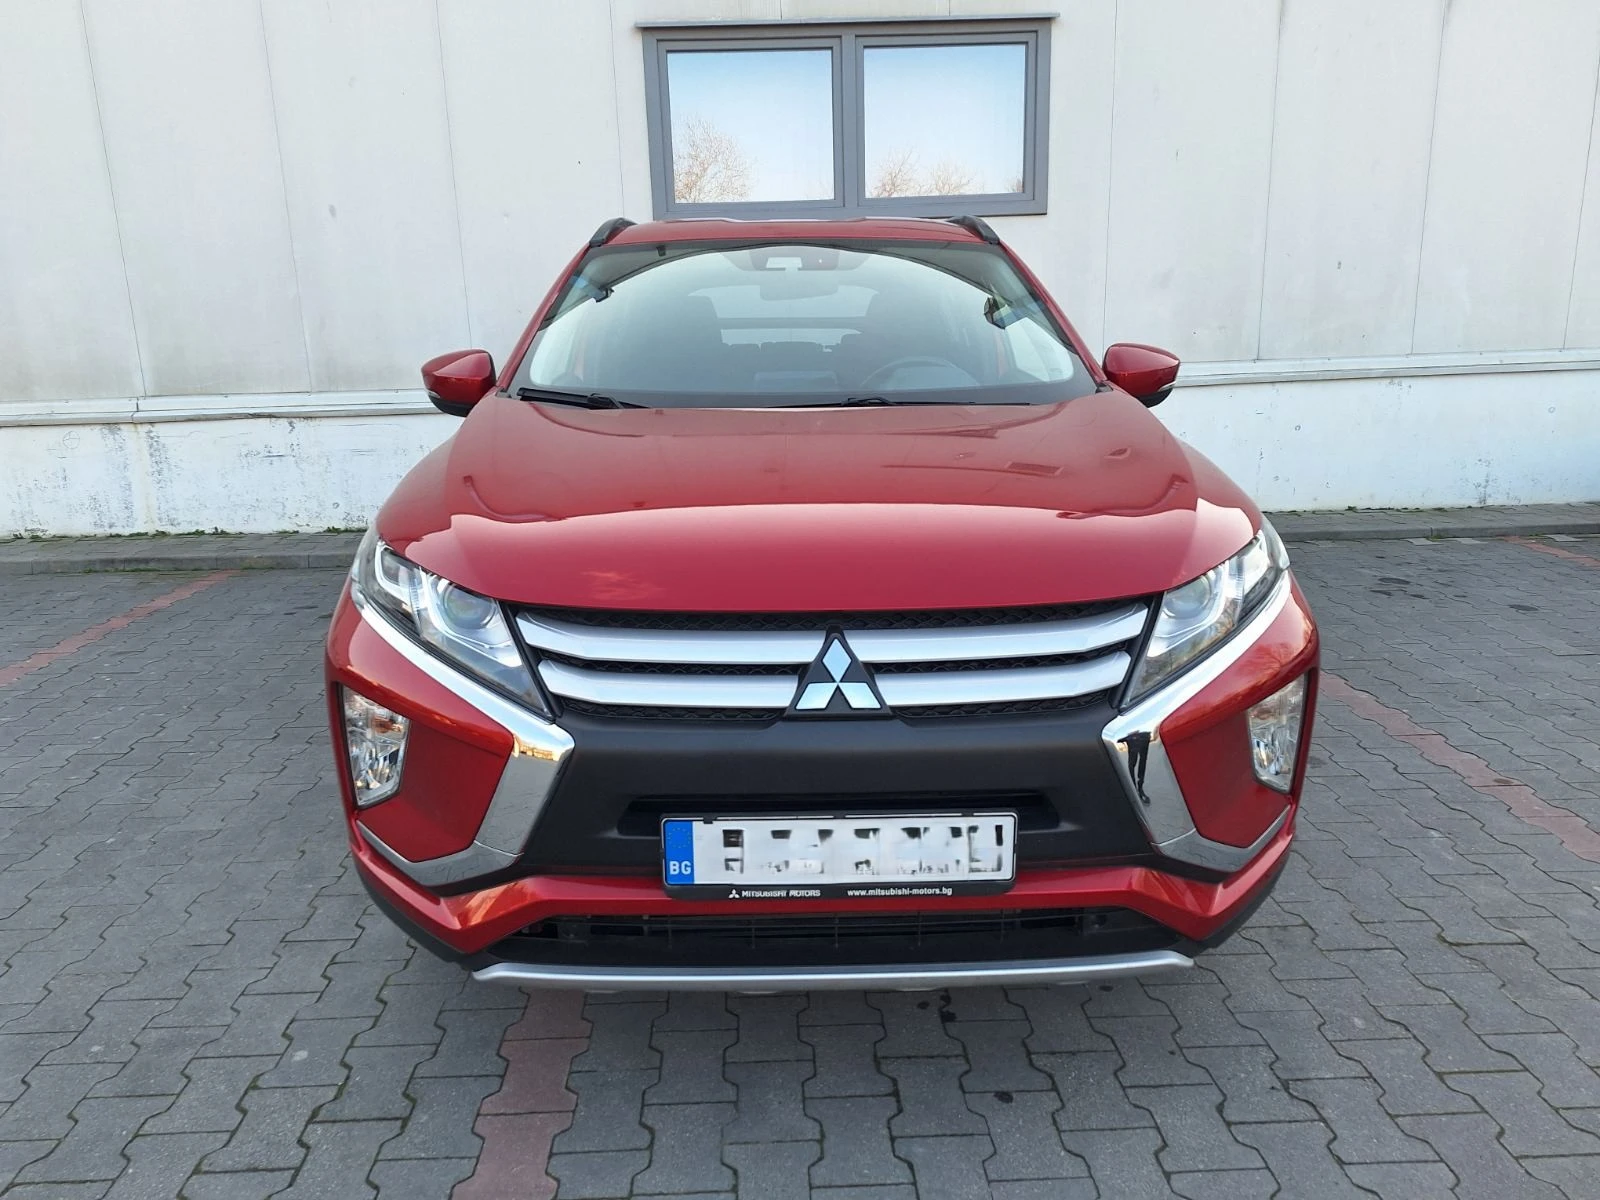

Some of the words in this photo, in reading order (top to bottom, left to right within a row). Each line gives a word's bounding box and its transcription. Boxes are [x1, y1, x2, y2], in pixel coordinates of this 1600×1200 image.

[669, 860, 692, 875] BG
[741, 890, 787, 898] MITSUBISHI
[789, 889, 821, 897] MOTORS
[847, 886, 953, 896] www.mitsubishi-motors.bg
